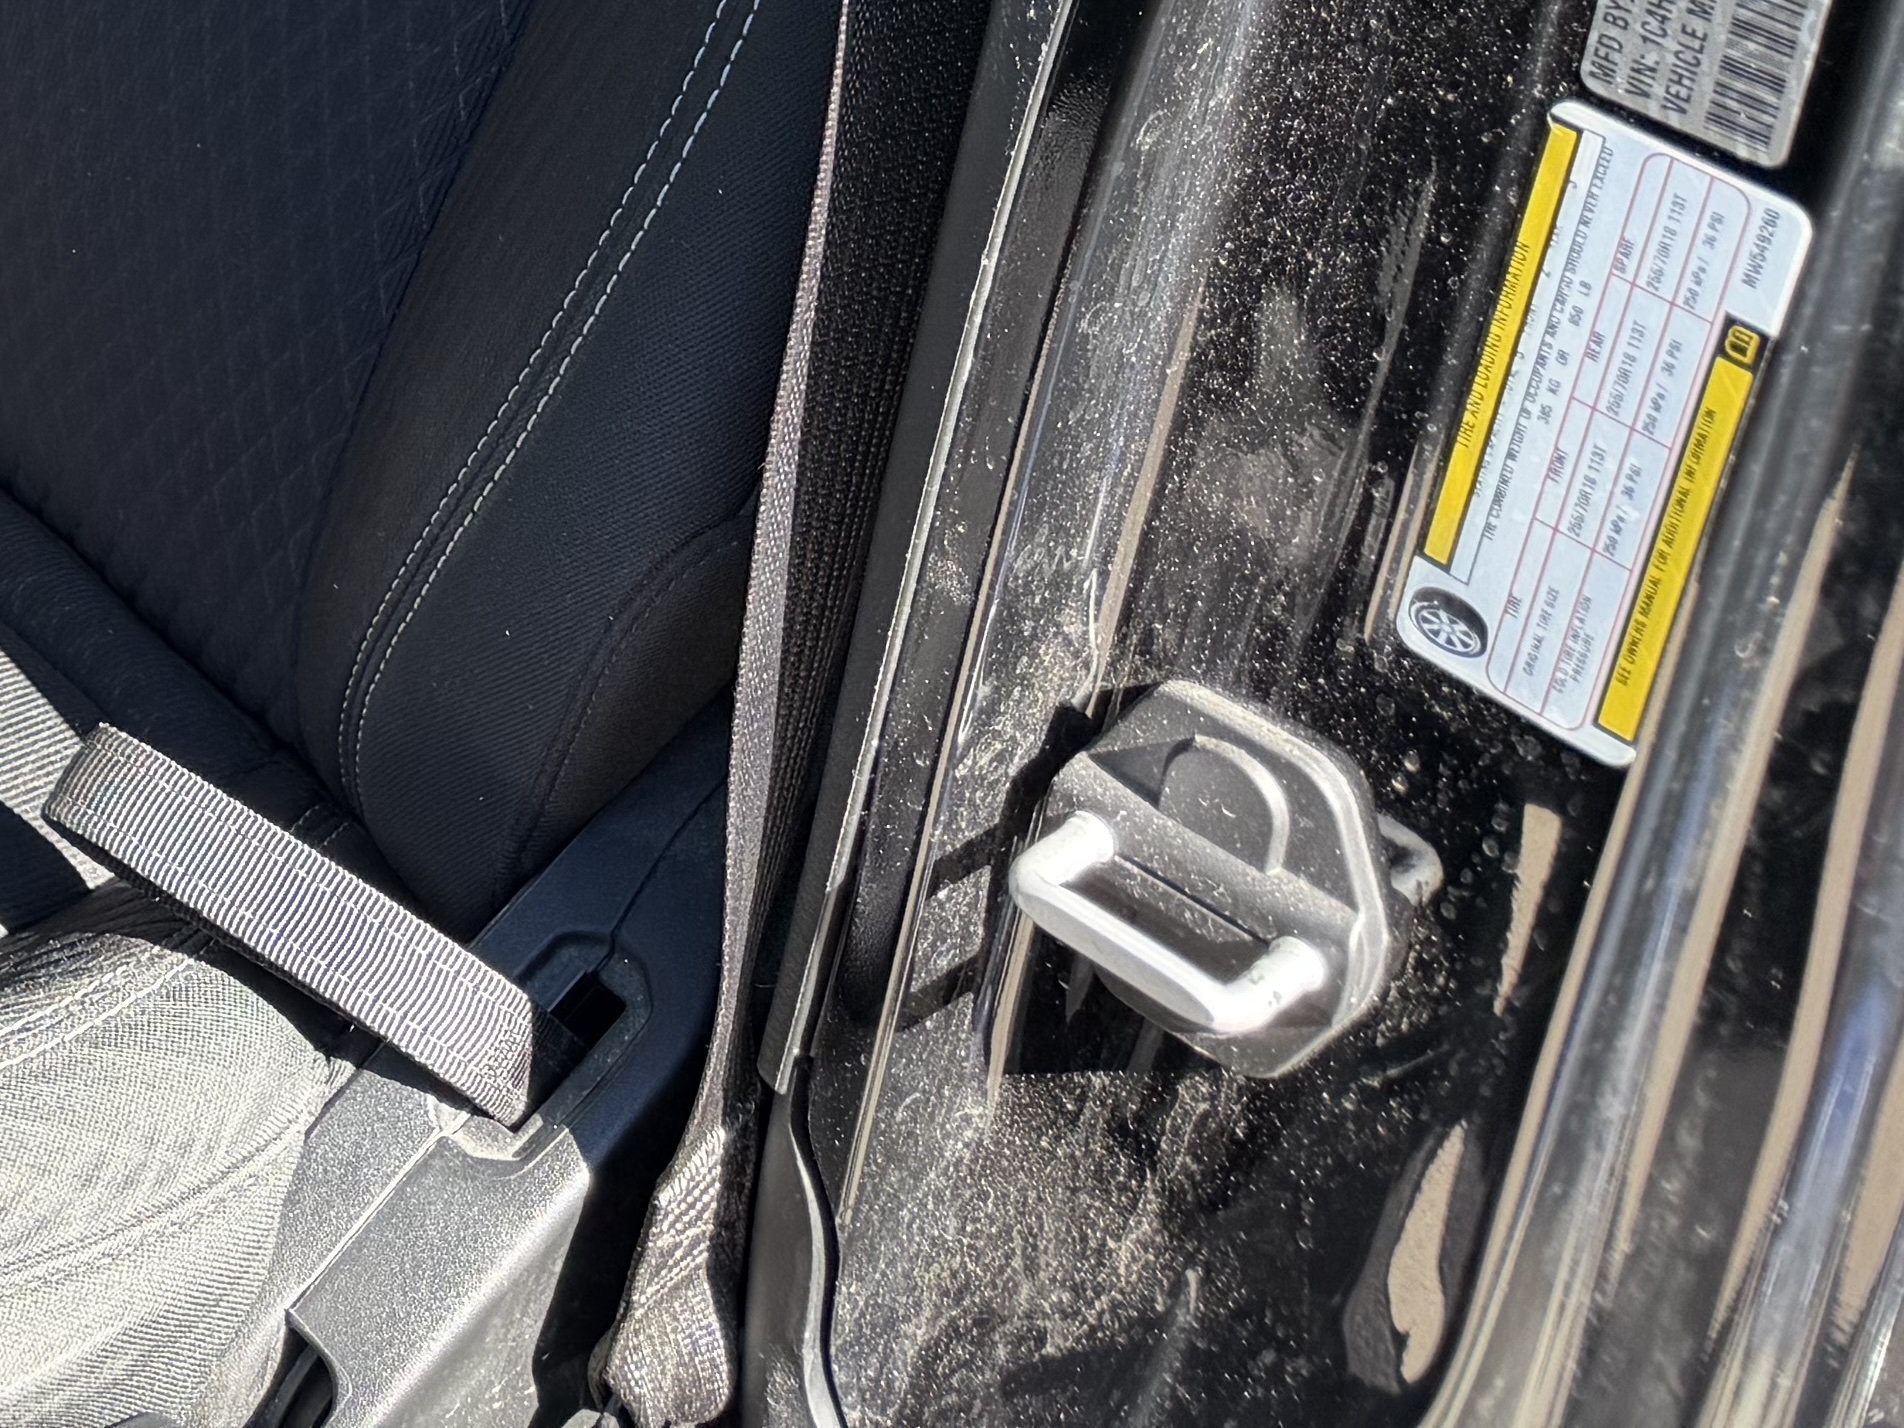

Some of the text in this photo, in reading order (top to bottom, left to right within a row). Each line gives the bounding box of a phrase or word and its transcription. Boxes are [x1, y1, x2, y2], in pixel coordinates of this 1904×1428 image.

[1588, 32, 1624, 86] MFD
[1624, 50, 1660, 103] VIN:
[1660, 22, 1708, 119] VEHICLE
[1590, 145, 1615, 190] EXCEED
[1578, 190, 1600, 229] NEVER
[1740, 205, 1782, 290] MW549260
[1490, 239, 1530, 331] INFORMATION
[1544, 314, 1561, 339] AND
[1545, 376, 1562, 397] KG
[1576, 278, 1593, 298] LB
[1584, 329, 1606, 363] REAR
[1473, 330, 1502, 390] LOADING
[1524, 338, 1554, 405] OCCUPANTS
[1464, 387, 1484, 419] AND
[1519, 404, 1533, 421] OF
[1455, 417, 1475, 449] TIRE
[1506, 420, 1528, 463] WEIGHT
[1546, 446, 1568, 484] FRONT
[1482, 519, 1497, 541] THE
[1504, 592, 1522, 619] TIRE
[1536, 607, 1553, 632] TIRE
